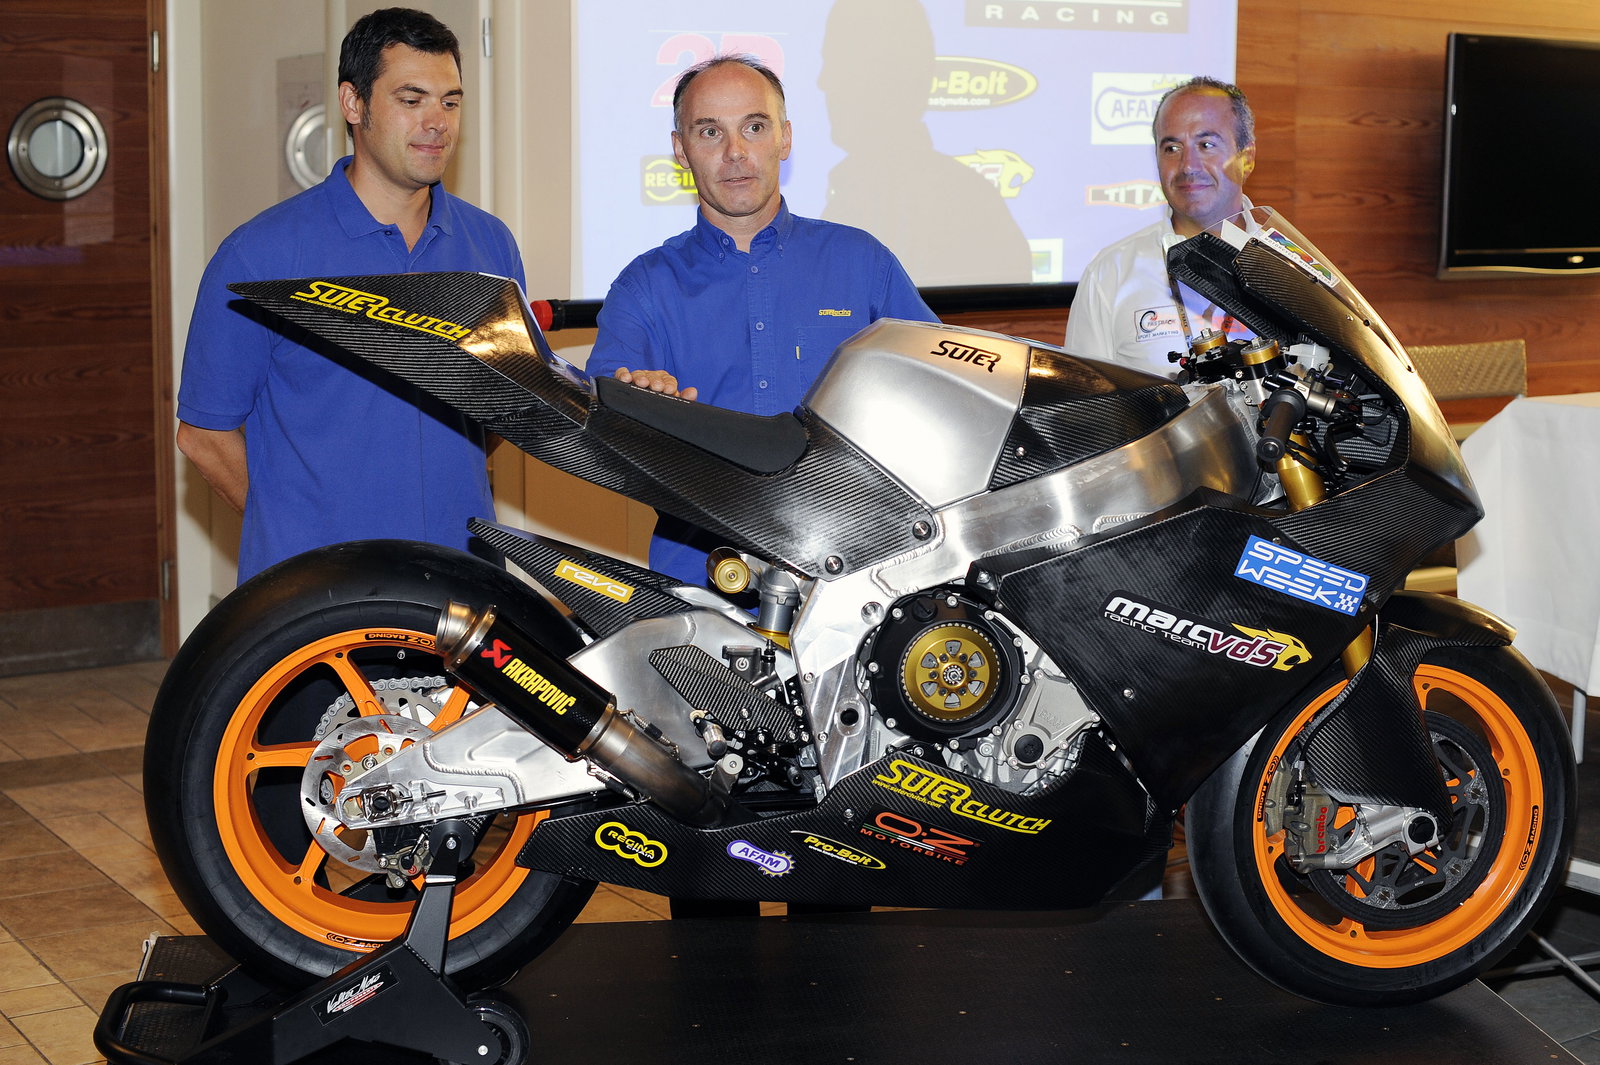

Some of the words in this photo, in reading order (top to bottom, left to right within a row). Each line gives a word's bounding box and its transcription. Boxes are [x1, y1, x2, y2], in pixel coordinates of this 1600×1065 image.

[984, 4, 1169, 26] RACING
[929, 71, 1008, 96] -Bolt
[645, 172, 697, 188] REGI
[1104, 183, 1167, 205] TITA
[930, 340, 1002, 373] SUTER
[1248, 541, 1366, 593] SPEED
[1238, 559, 1338, 606] WEEK
[501, 658, 577, 715] AKRAPOVIČ
[871, 779, 942, 808] www.suterclutch.com
[607, 830, 655, 857] REGINA
[1316, 806, 1328, 853] brembo
[626, 844, 655, 860] CHAIN
[738, 846, 781, 868] AFAM
[803, 835, 873, 866] Pro-Bolt
[860, 828, 965, 866] MOTORBIKE
